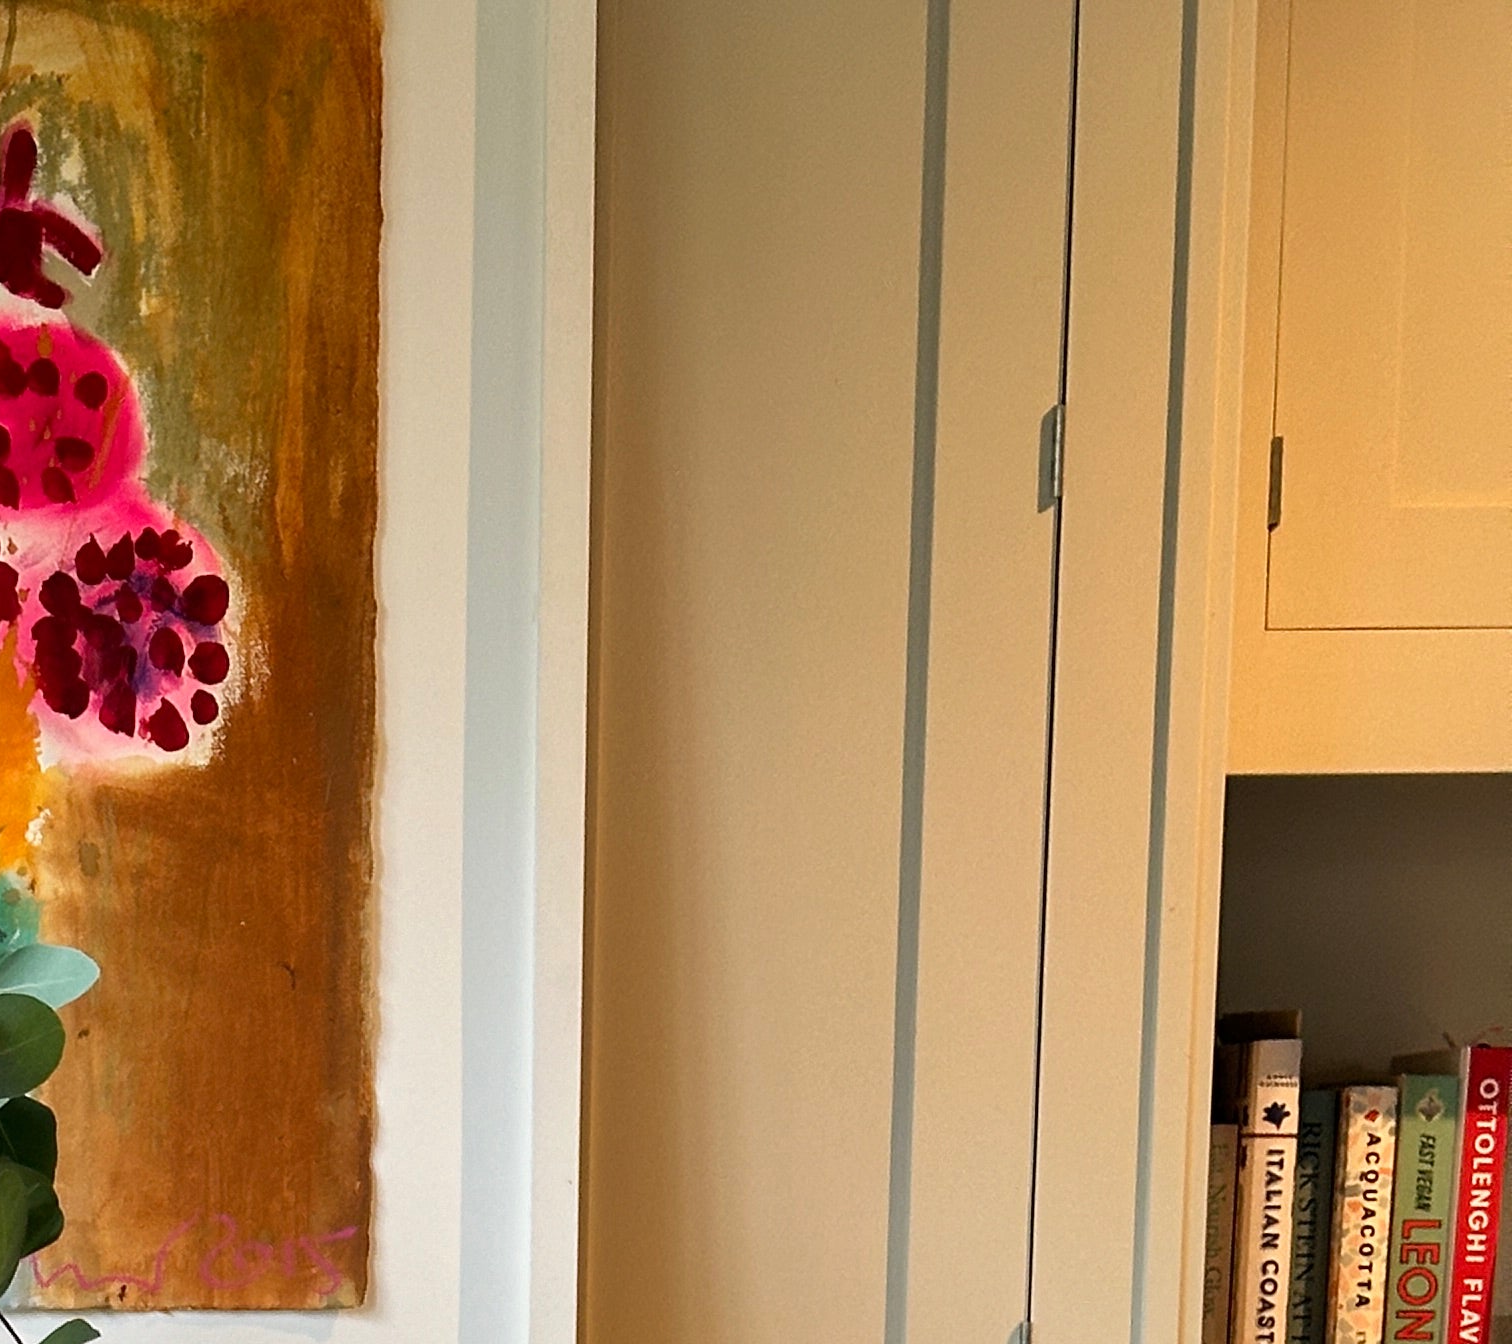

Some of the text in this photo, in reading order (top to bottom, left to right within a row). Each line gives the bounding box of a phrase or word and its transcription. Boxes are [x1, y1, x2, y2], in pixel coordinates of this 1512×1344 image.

[1260, 1149, 1285, 1250] ITALIAN
[1297, 1121, 1321, 1190] RICK
[1414, 1133, 1436, 1212] FAST VEGAN
[1466, 1078, 1500, 1263] OTTOLENGHI
[1294, 1197, 1316, 1281] STEIN
[1355, 1132, 1381, 1308] ACQUACOTTA
[1292, 1296, 1312, 1326] AT
[1394, 1218, 1442, 1342] LEON
